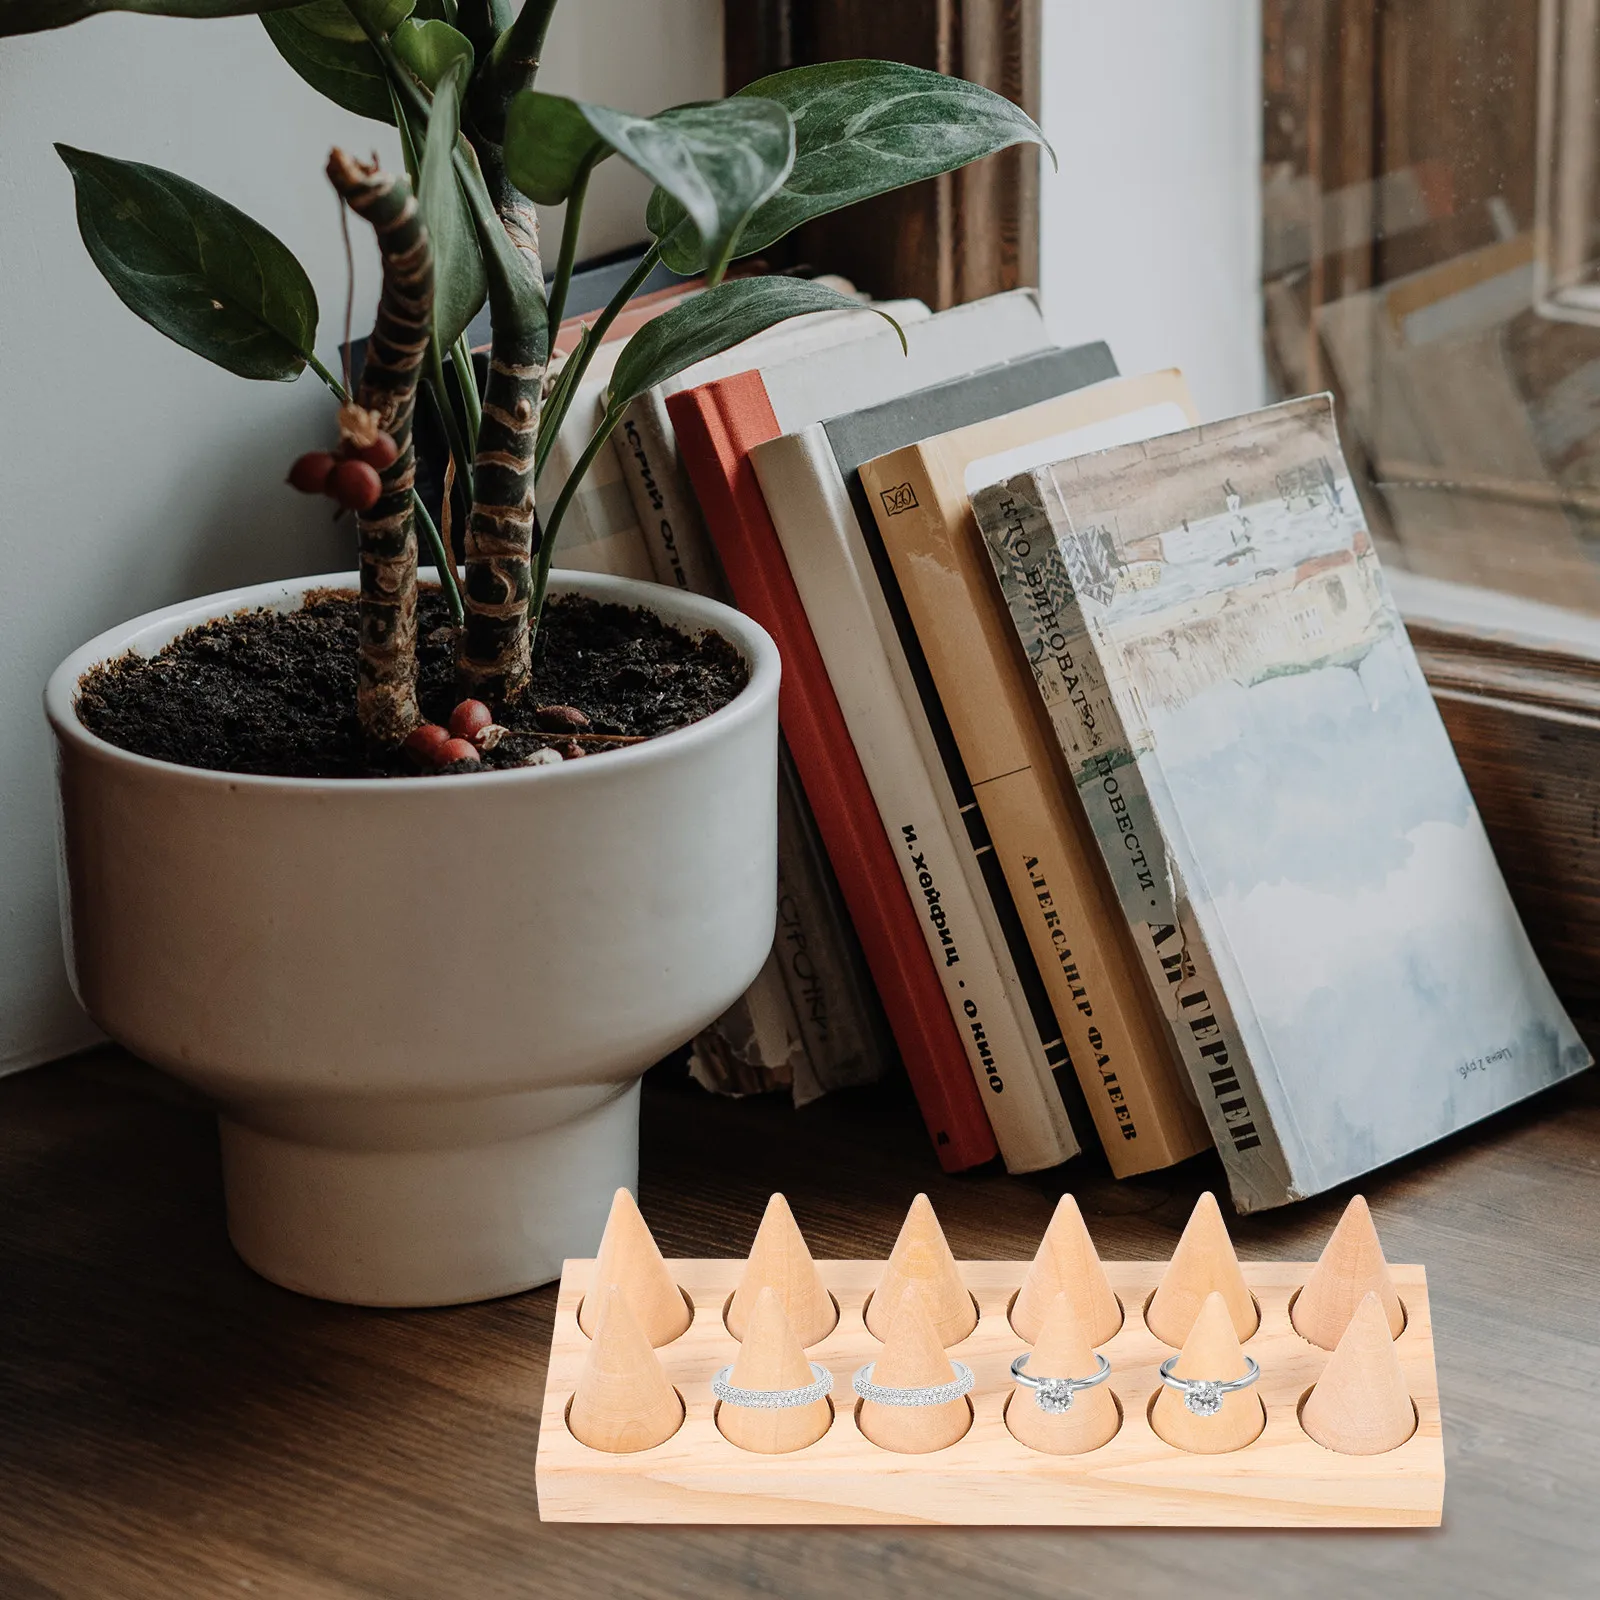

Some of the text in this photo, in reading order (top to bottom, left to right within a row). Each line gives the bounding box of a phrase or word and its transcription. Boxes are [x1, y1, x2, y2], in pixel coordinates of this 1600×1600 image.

[624, 419, 689, 591] ЮРИЙ ОЛЕ
[1000, 497, 1031, 557] КТО
[1095, 755, 1156, 891] ПОВЕСТИ
[1180, 988, 1262, 1153] ГЕРЦЕН
[1022, 853, 1138, 1142] АЛЕКСАНДР ФАДЕЕВ
[1477, 1058, 1487, 1071] 2
[1484, 1047, 1514, 1065] Цена
